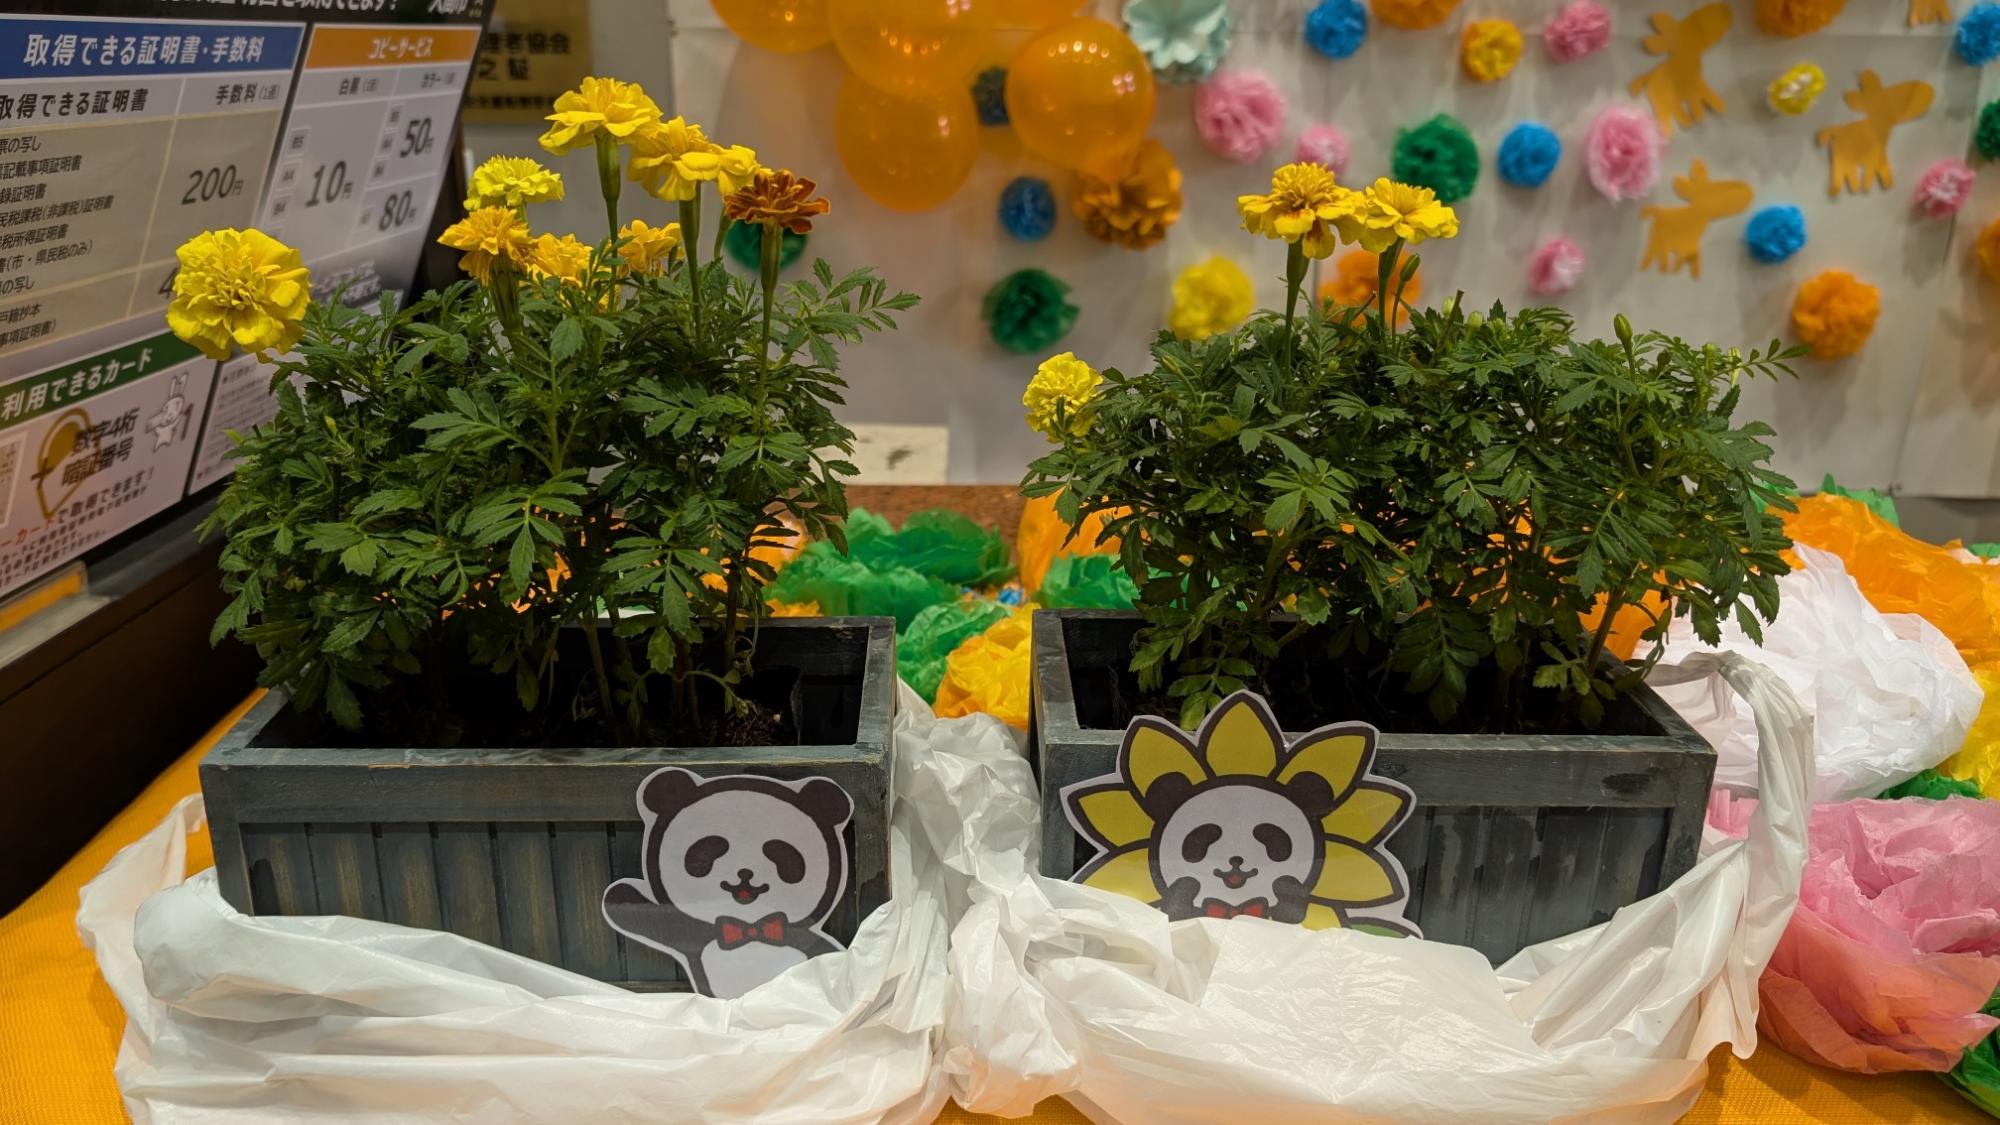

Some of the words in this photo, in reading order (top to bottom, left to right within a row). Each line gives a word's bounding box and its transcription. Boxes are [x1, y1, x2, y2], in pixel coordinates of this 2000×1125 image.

[24, 34, 265, 67] 取得できる証明書・手数料
[0, 223, 69, 251] 税所得証明書
[2, 348, 152, 420] 利用できるカード
